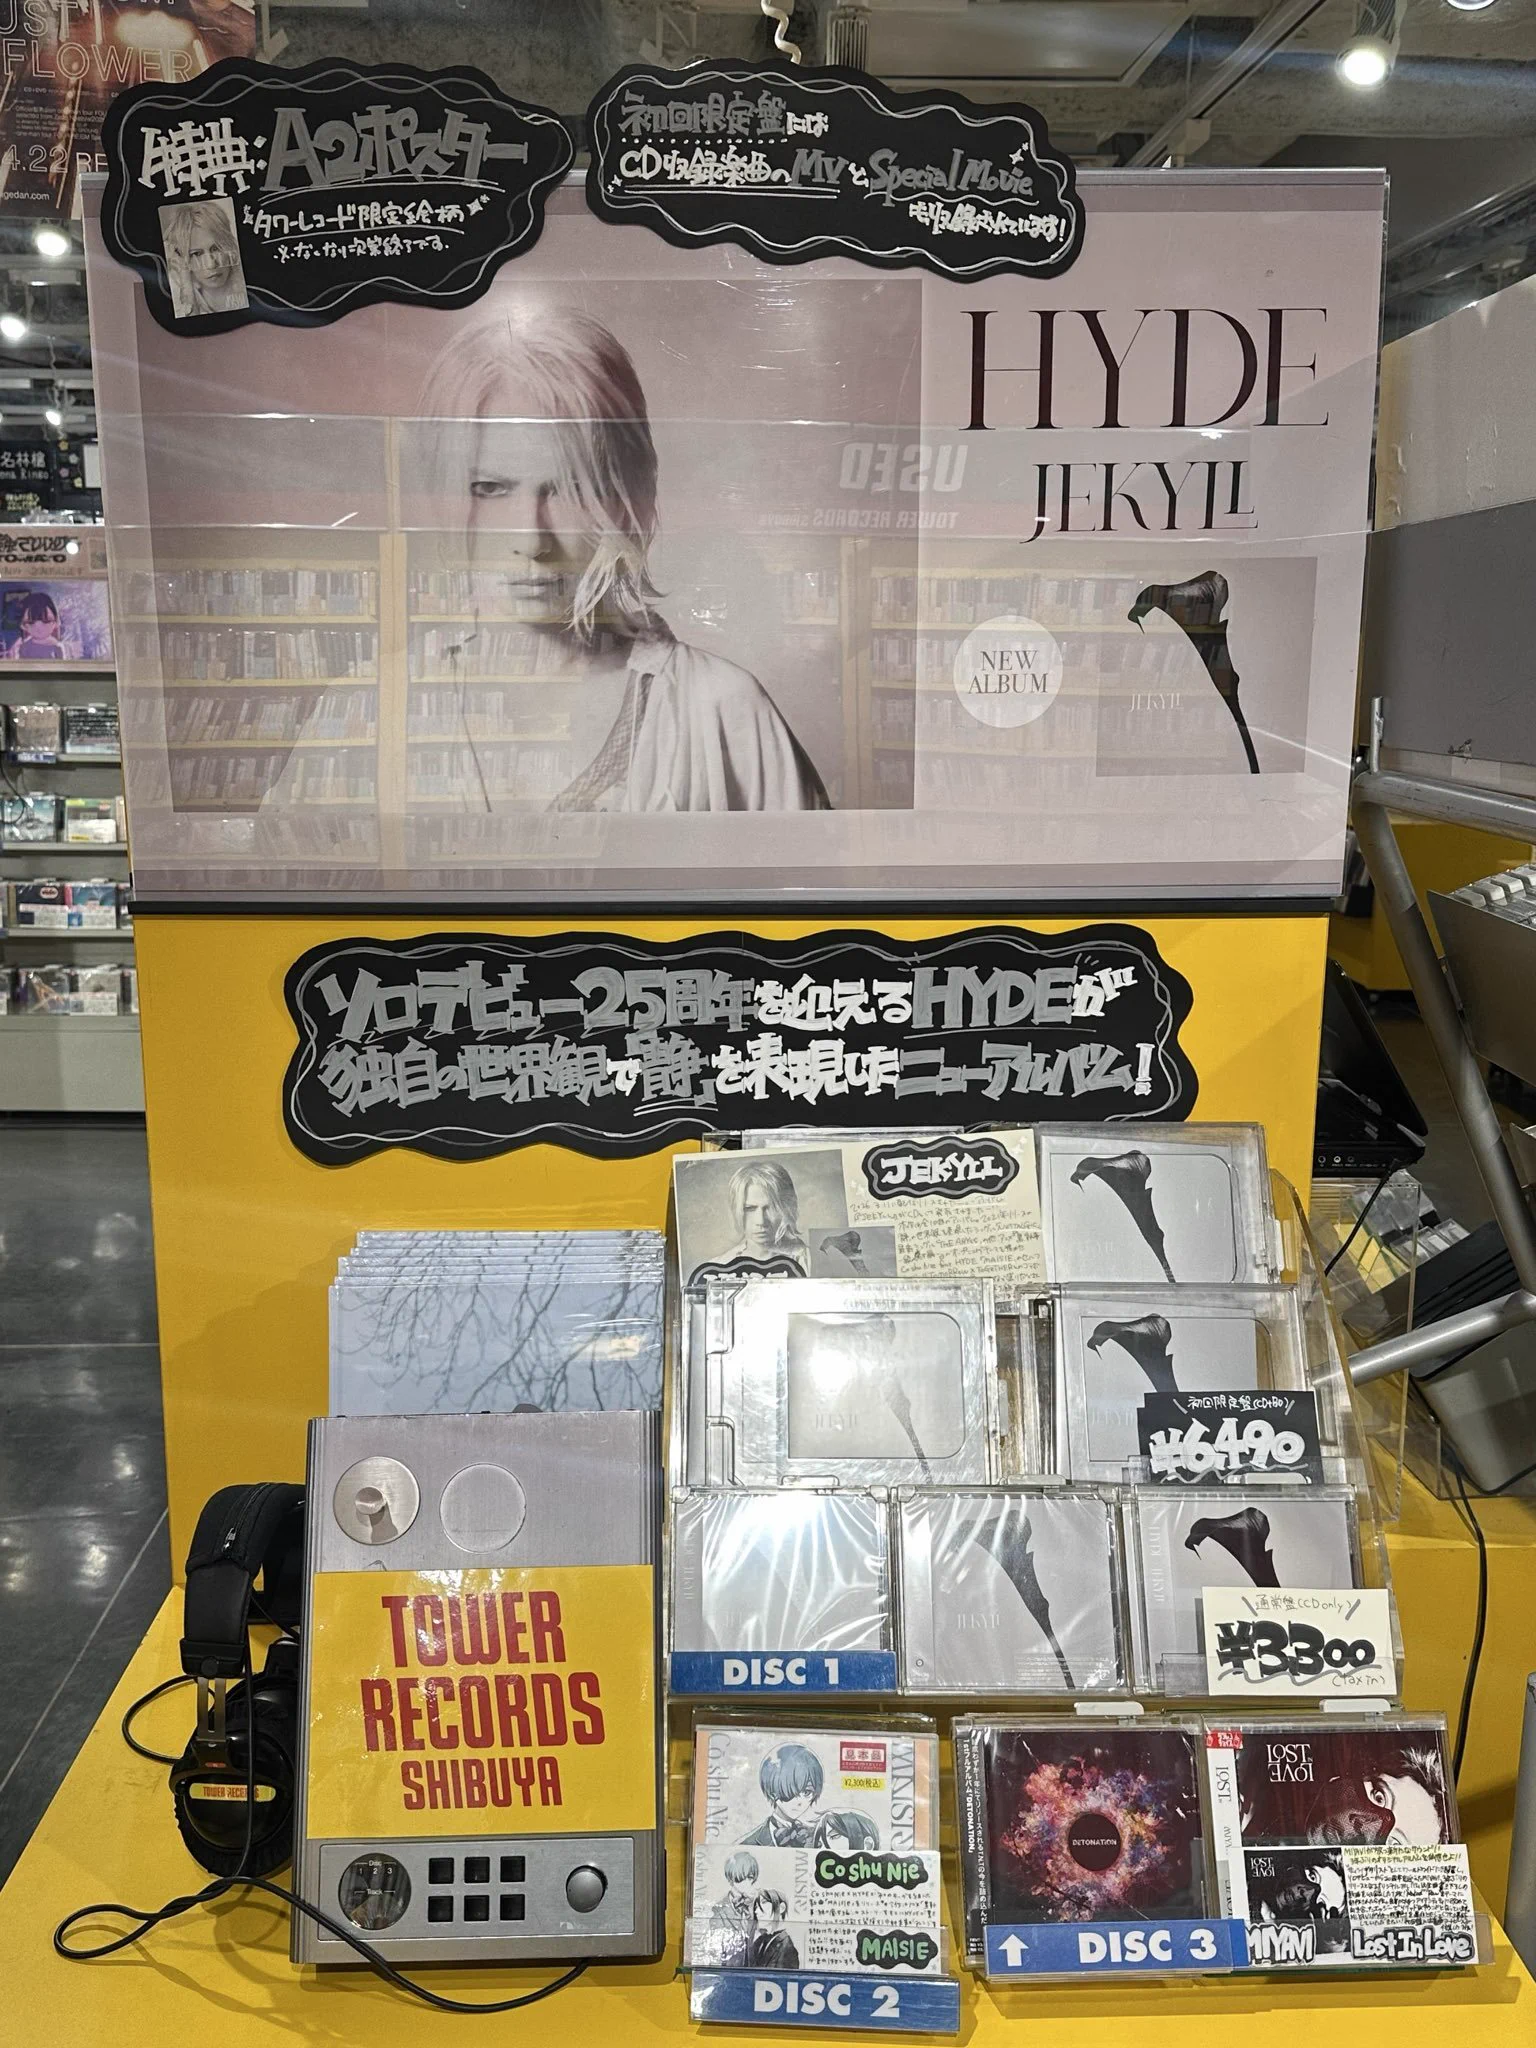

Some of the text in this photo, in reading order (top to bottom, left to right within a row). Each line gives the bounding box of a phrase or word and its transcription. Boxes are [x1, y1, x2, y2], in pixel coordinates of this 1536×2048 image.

[3, 38, 193, 84] FLOWER
[868, 148, 960, 207] Special
[957, 158, 1033, 196] Movie
[958, 307, 1330, 431] HYDE
[1018, 461, 1259, 544] JEKYLL
[980, 649, 1039, 672] NEW
[968, 673, 1049, 695] ALBUM
[314, 959, 1137, 1043] ソロデビュー25周年を迎えるHYDEが
[881, 1152, 1003, 1185] JEKYLL
[1149, 1417, 1306, 1480] ¥6490
[381, 1590, 566, 1668] TOWER
[1215, 1620, 1376, 1677] ¥3300
[723, 1658, 840, 1687] DISC 1
[360, 1671, 605, 1753] RECORDS
[1266, 1743, 1311, 1763] LOST
[203, 1787, 225, 1798] TOWER
[400, 1756, 563, 1811] SHIBUYA
[1072, 1838, 1118, 1847] DETONATION
[819, 1858, 922, 1886] Co shu Nie
[366, 1888, 383, 1896] Track
[862, 1937, 930, 1961] MAISIE
[1078, 1928, 1218, 1964] DISC 3
[1353, 1926, 1474, 1960] Lost In Love
[754, 1981, 901, 2019] DISC 2
